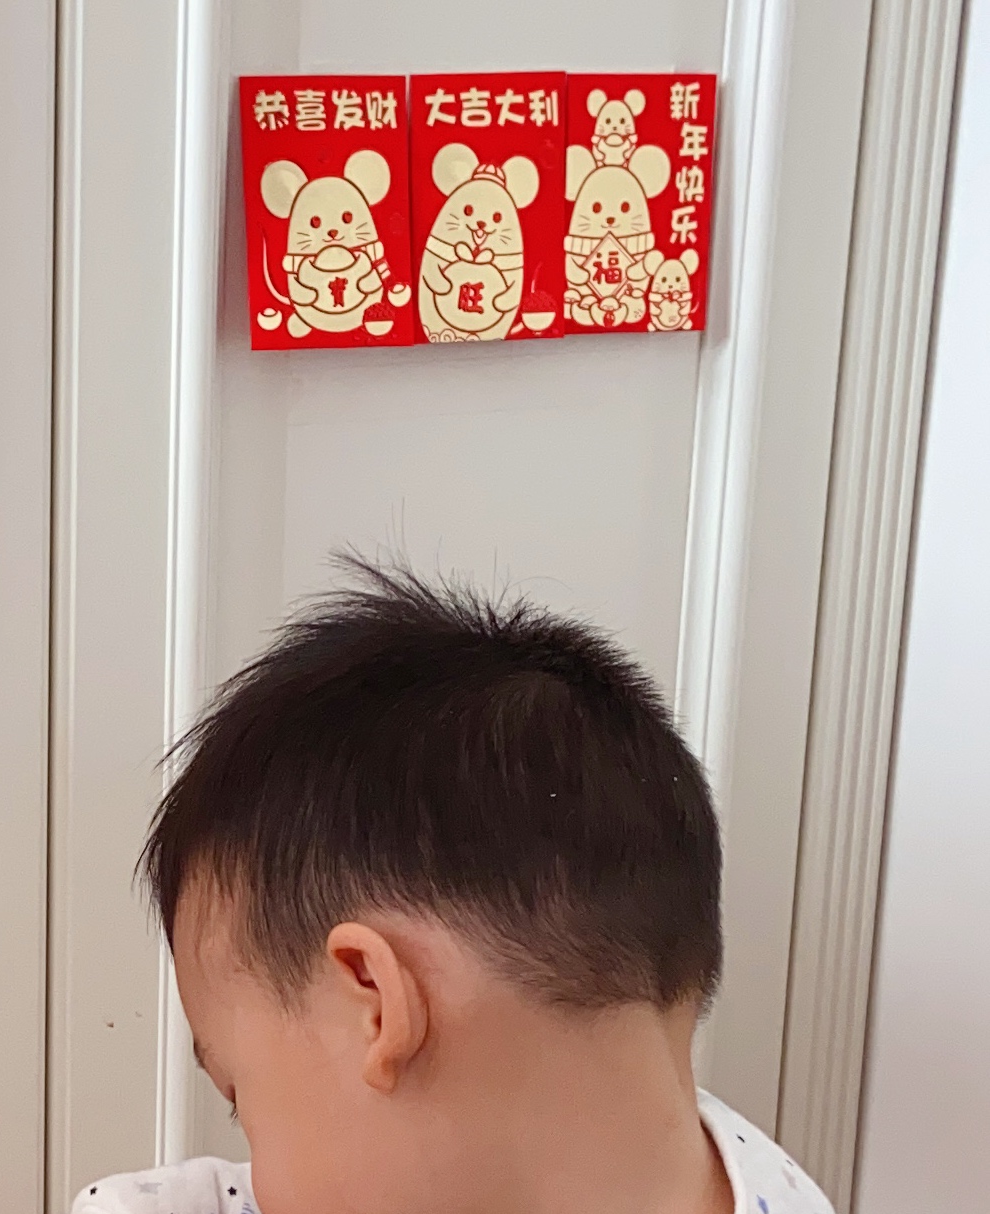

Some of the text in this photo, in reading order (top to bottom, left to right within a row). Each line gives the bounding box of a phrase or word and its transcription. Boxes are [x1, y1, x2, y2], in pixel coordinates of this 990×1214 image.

[252, 88, 399, 132] 恭喜发财
[424, 86, 559, 128] 大吉大利
[669, 81, 709, 245] 新年快乐
[592, 250, 623, 285] 福
[457, 281, 485, 315] 旺
